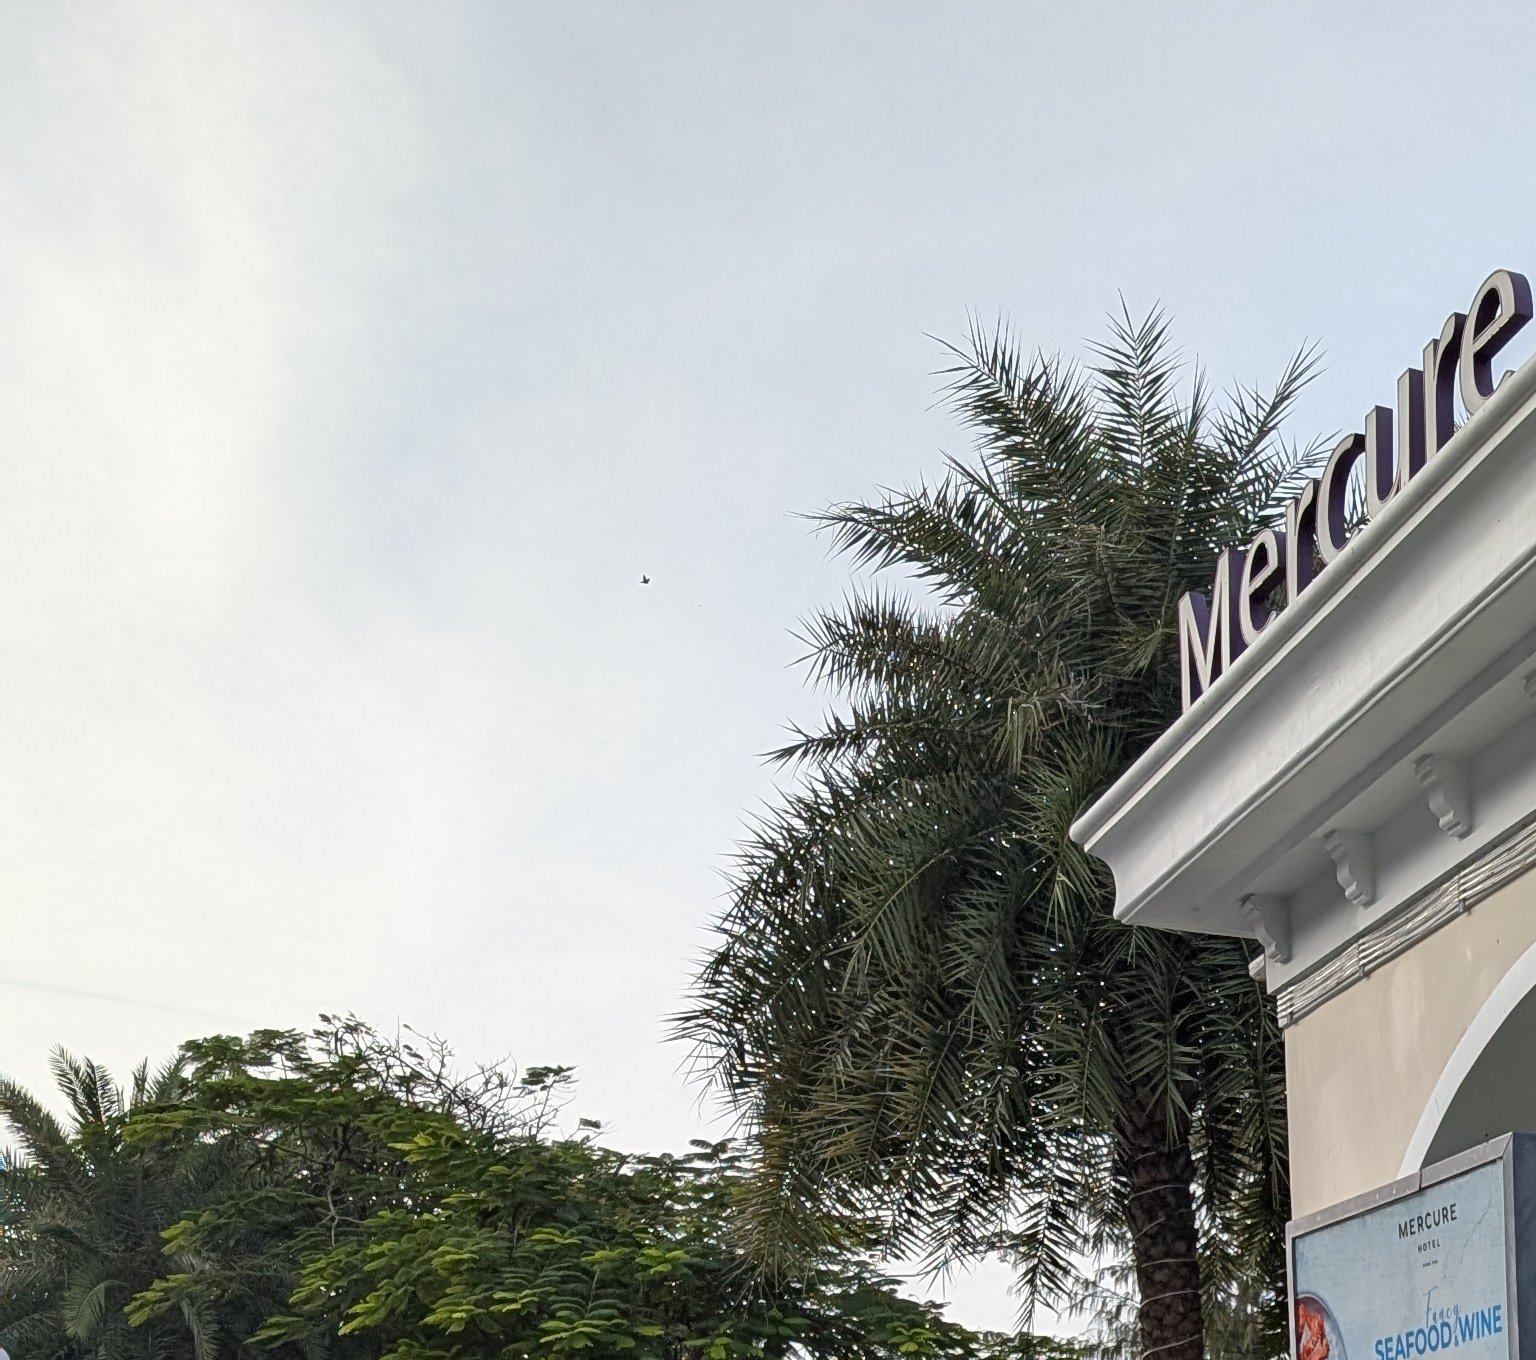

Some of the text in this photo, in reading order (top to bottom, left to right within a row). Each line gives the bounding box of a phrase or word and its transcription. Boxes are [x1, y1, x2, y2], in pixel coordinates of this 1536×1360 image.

[1178, 269, 1533, 714] Mercure
[1398, 1203, 1458, 1239] MERCURE
[1417, 1239, 1441, 1253] HOTEL
[1458, 1304, 1502, 1343] WINE
